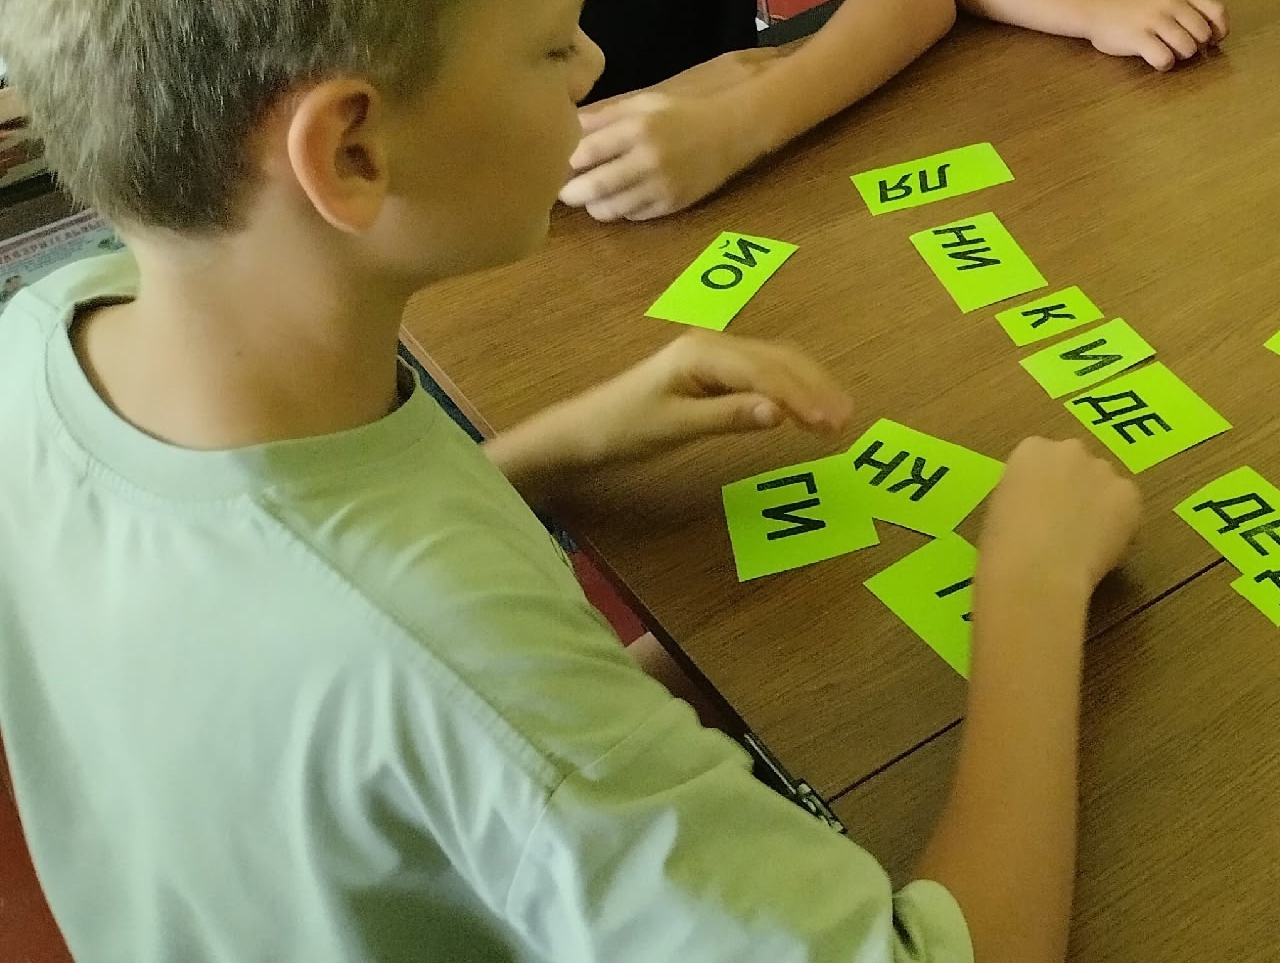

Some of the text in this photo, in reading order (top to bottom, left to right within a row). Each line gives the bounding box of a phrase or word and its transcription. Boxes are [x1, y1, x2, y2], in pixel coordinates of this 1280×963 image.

[878, 163, 951, 204] ЛЯ
[700, 237, 771, 290] ОЙ
[931, 224, 1001, 271] НИ
[1021, 303, 1076, 328] К
[1059, 338, 1124, 376] И
[1072, 389, 1173, 445] ДЕ
[853, 439, 949, 502] КН
[756, 471, 826, 541] ГИ
